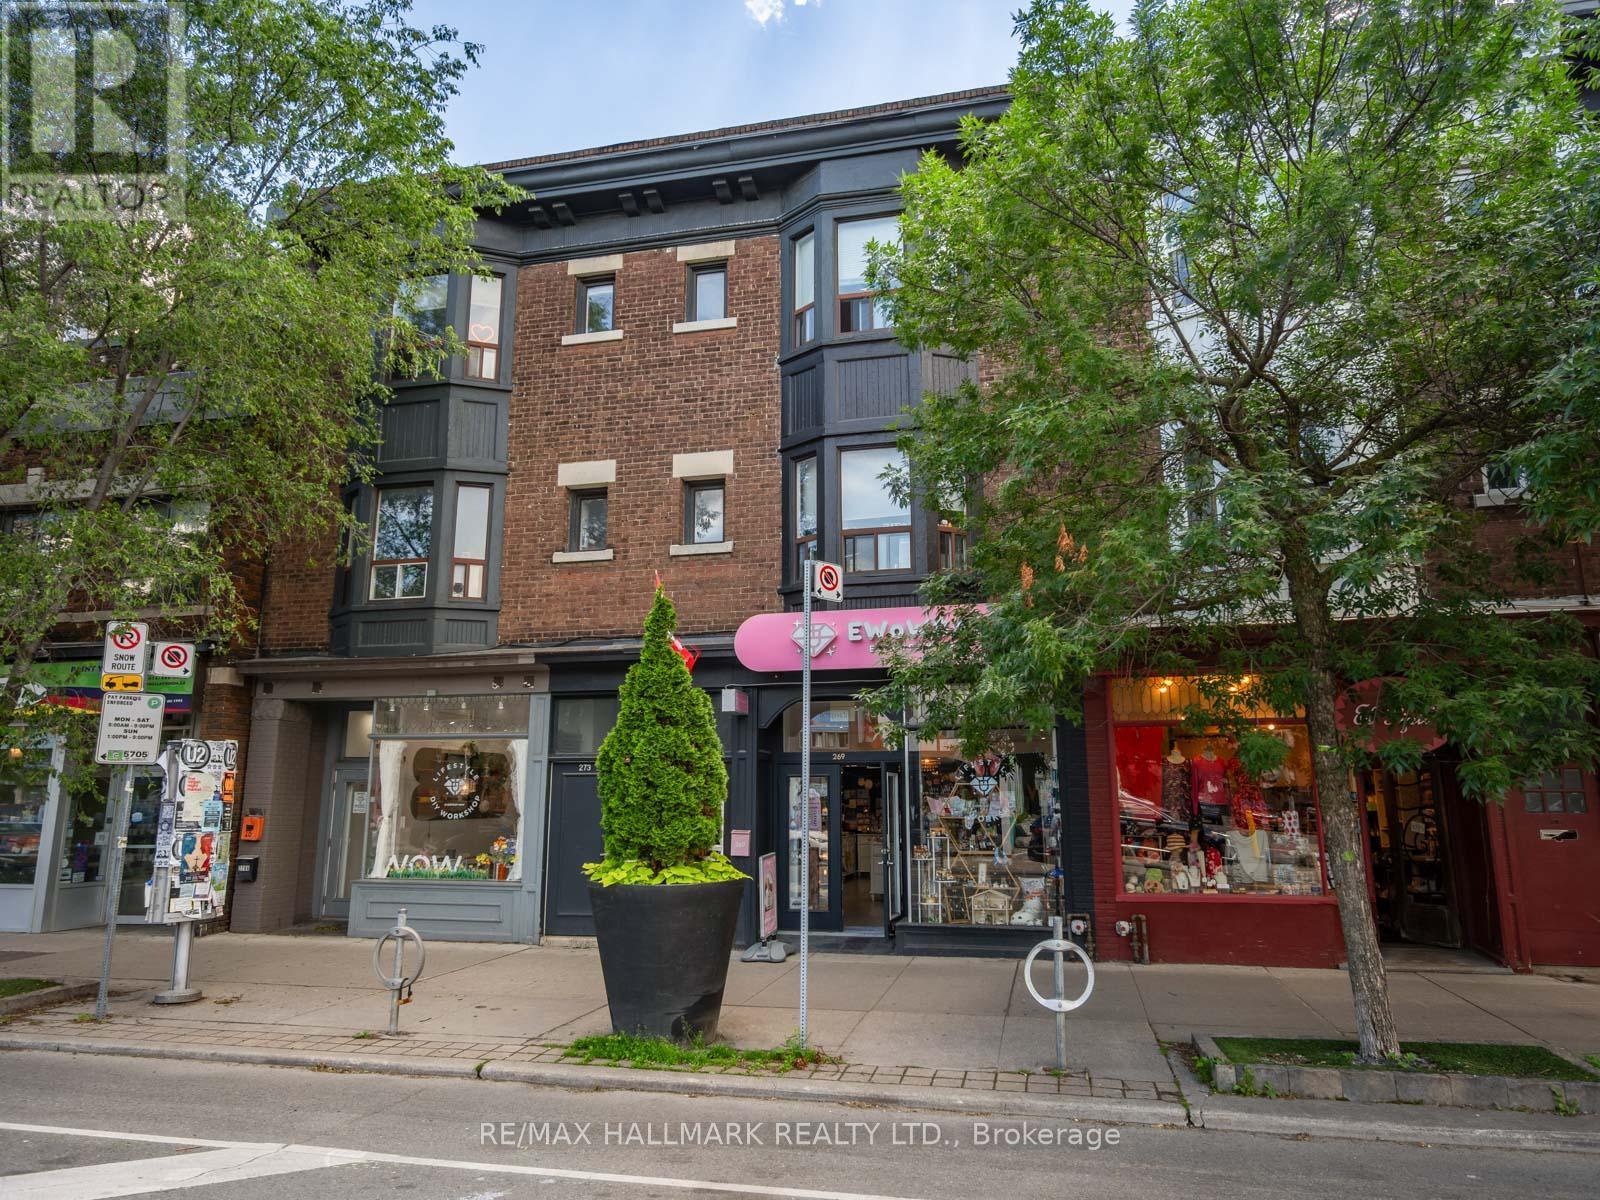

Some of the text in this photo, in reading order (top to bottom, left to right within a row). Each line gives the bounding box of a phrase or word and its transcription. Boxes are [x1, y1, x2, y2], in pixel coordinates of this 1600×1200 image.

[114, 653, 136, 662] SNOW
[111, 663, 136, 671] ROUTE
[186, 746, 206, 763] U2
[432, 762, 480, 782] LIFESTYLE
[578, 763, 592, 772] 273
[430, 795, 480, 820] DIY WORKSHOP
